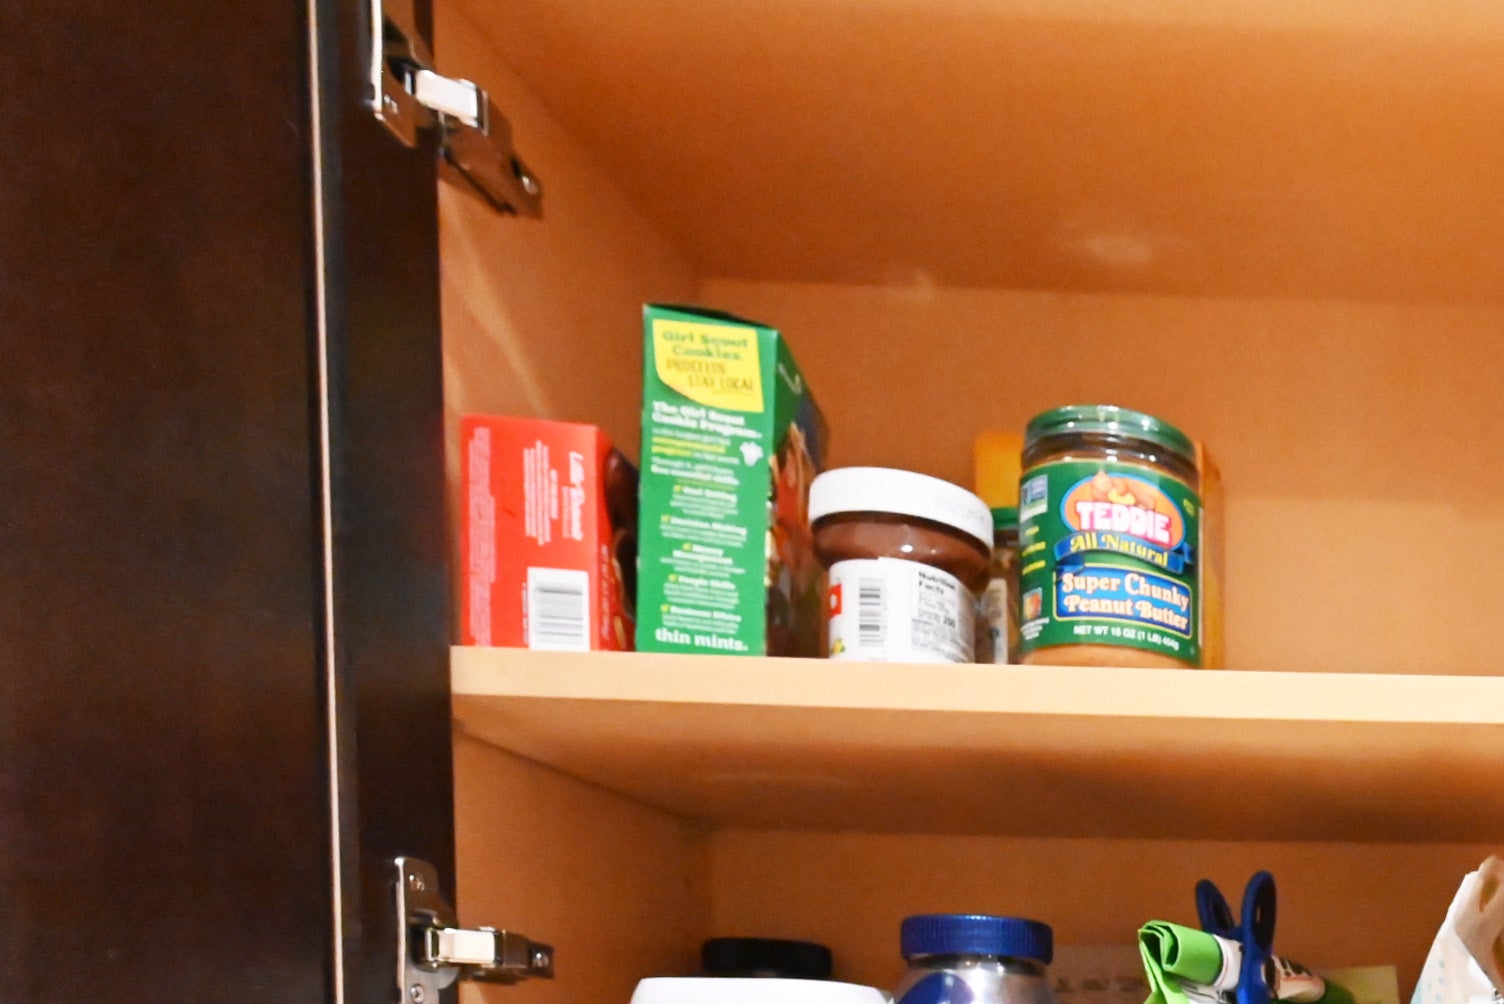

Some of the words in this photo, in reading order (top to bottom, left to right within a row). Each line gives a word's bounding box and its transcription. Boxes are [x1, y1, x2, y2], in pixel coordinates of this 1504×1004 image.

[662, 330, 694, 343] Girl
[700, 334, 748, 347] Scout
[672, 345, 743, 360] Cookies
[1075, 501, 1172, 544] TEDDIE
[1070, 532, 1097, 552] All
[1101, 533, 1169, 567] Natural
[1062, 572, 1121, 594] Super
[1125, 573, 1189, 612] Chunky
[1063, 594, 1135, 616] Peanut
[1135, 599, 1189, 630] Butter
[655, 627, 691, 645] thin
[1073, 624, 1092, 635] NET
[1094, 625, 1108, 636] WT
[1122, 628, 1137, 640] OZ
